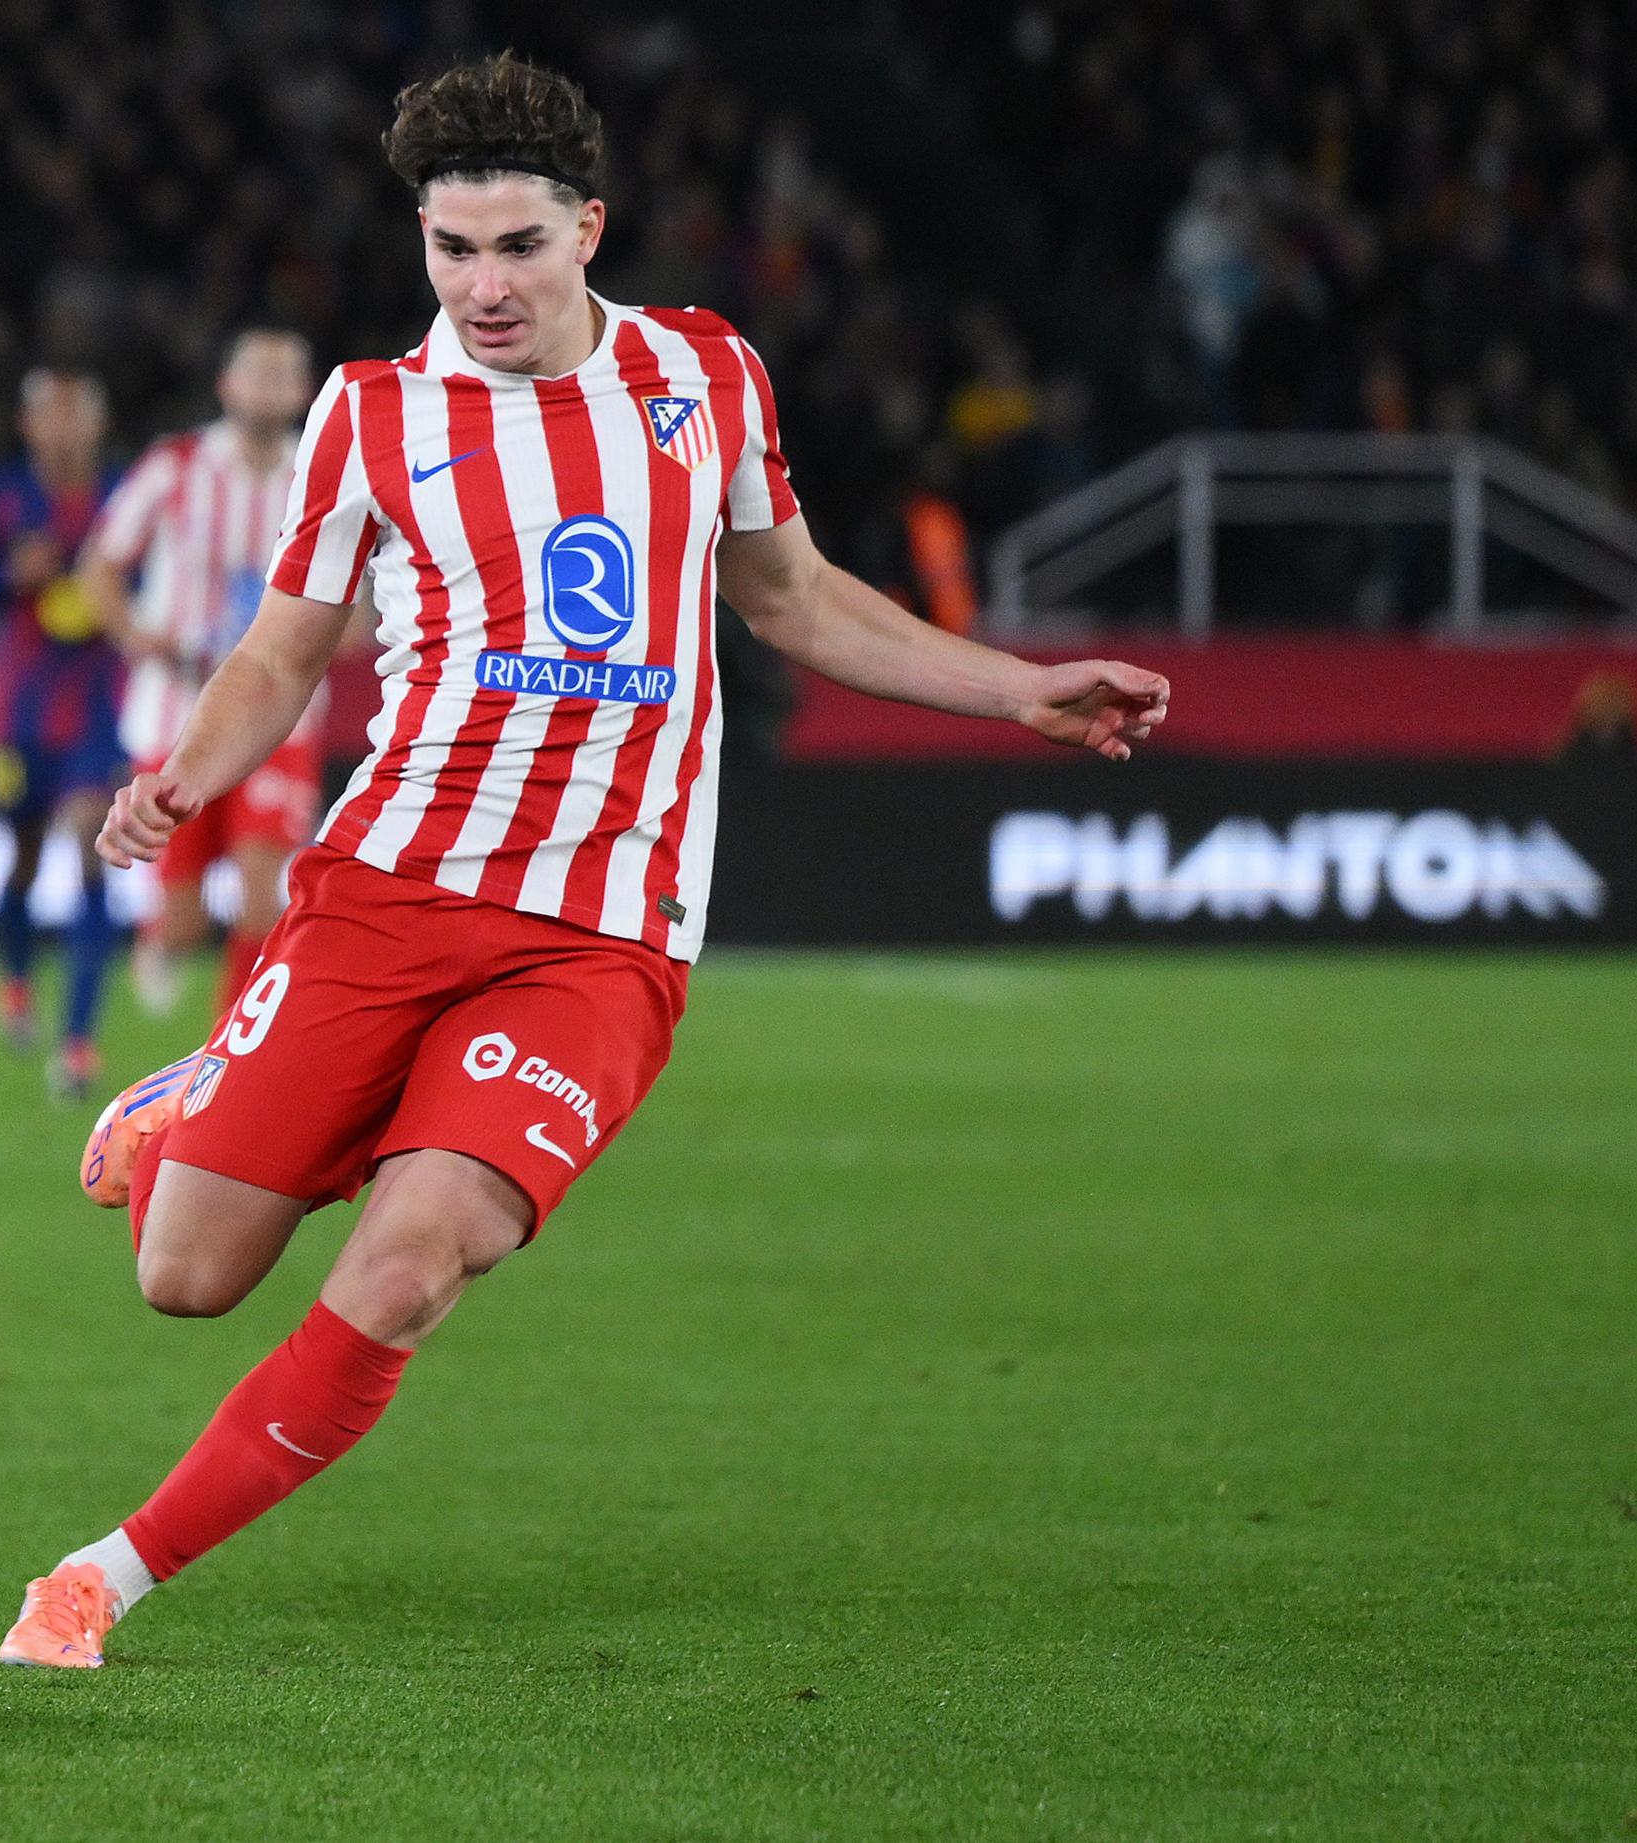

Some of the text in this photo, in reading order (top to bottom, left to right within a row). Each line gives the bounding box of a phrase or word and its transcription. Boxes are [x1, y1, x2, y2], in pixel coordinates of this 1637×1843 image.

[483, 655, 671, 700] RIYADH AIR
[989, 809, 1605, 922] PHANTOM
